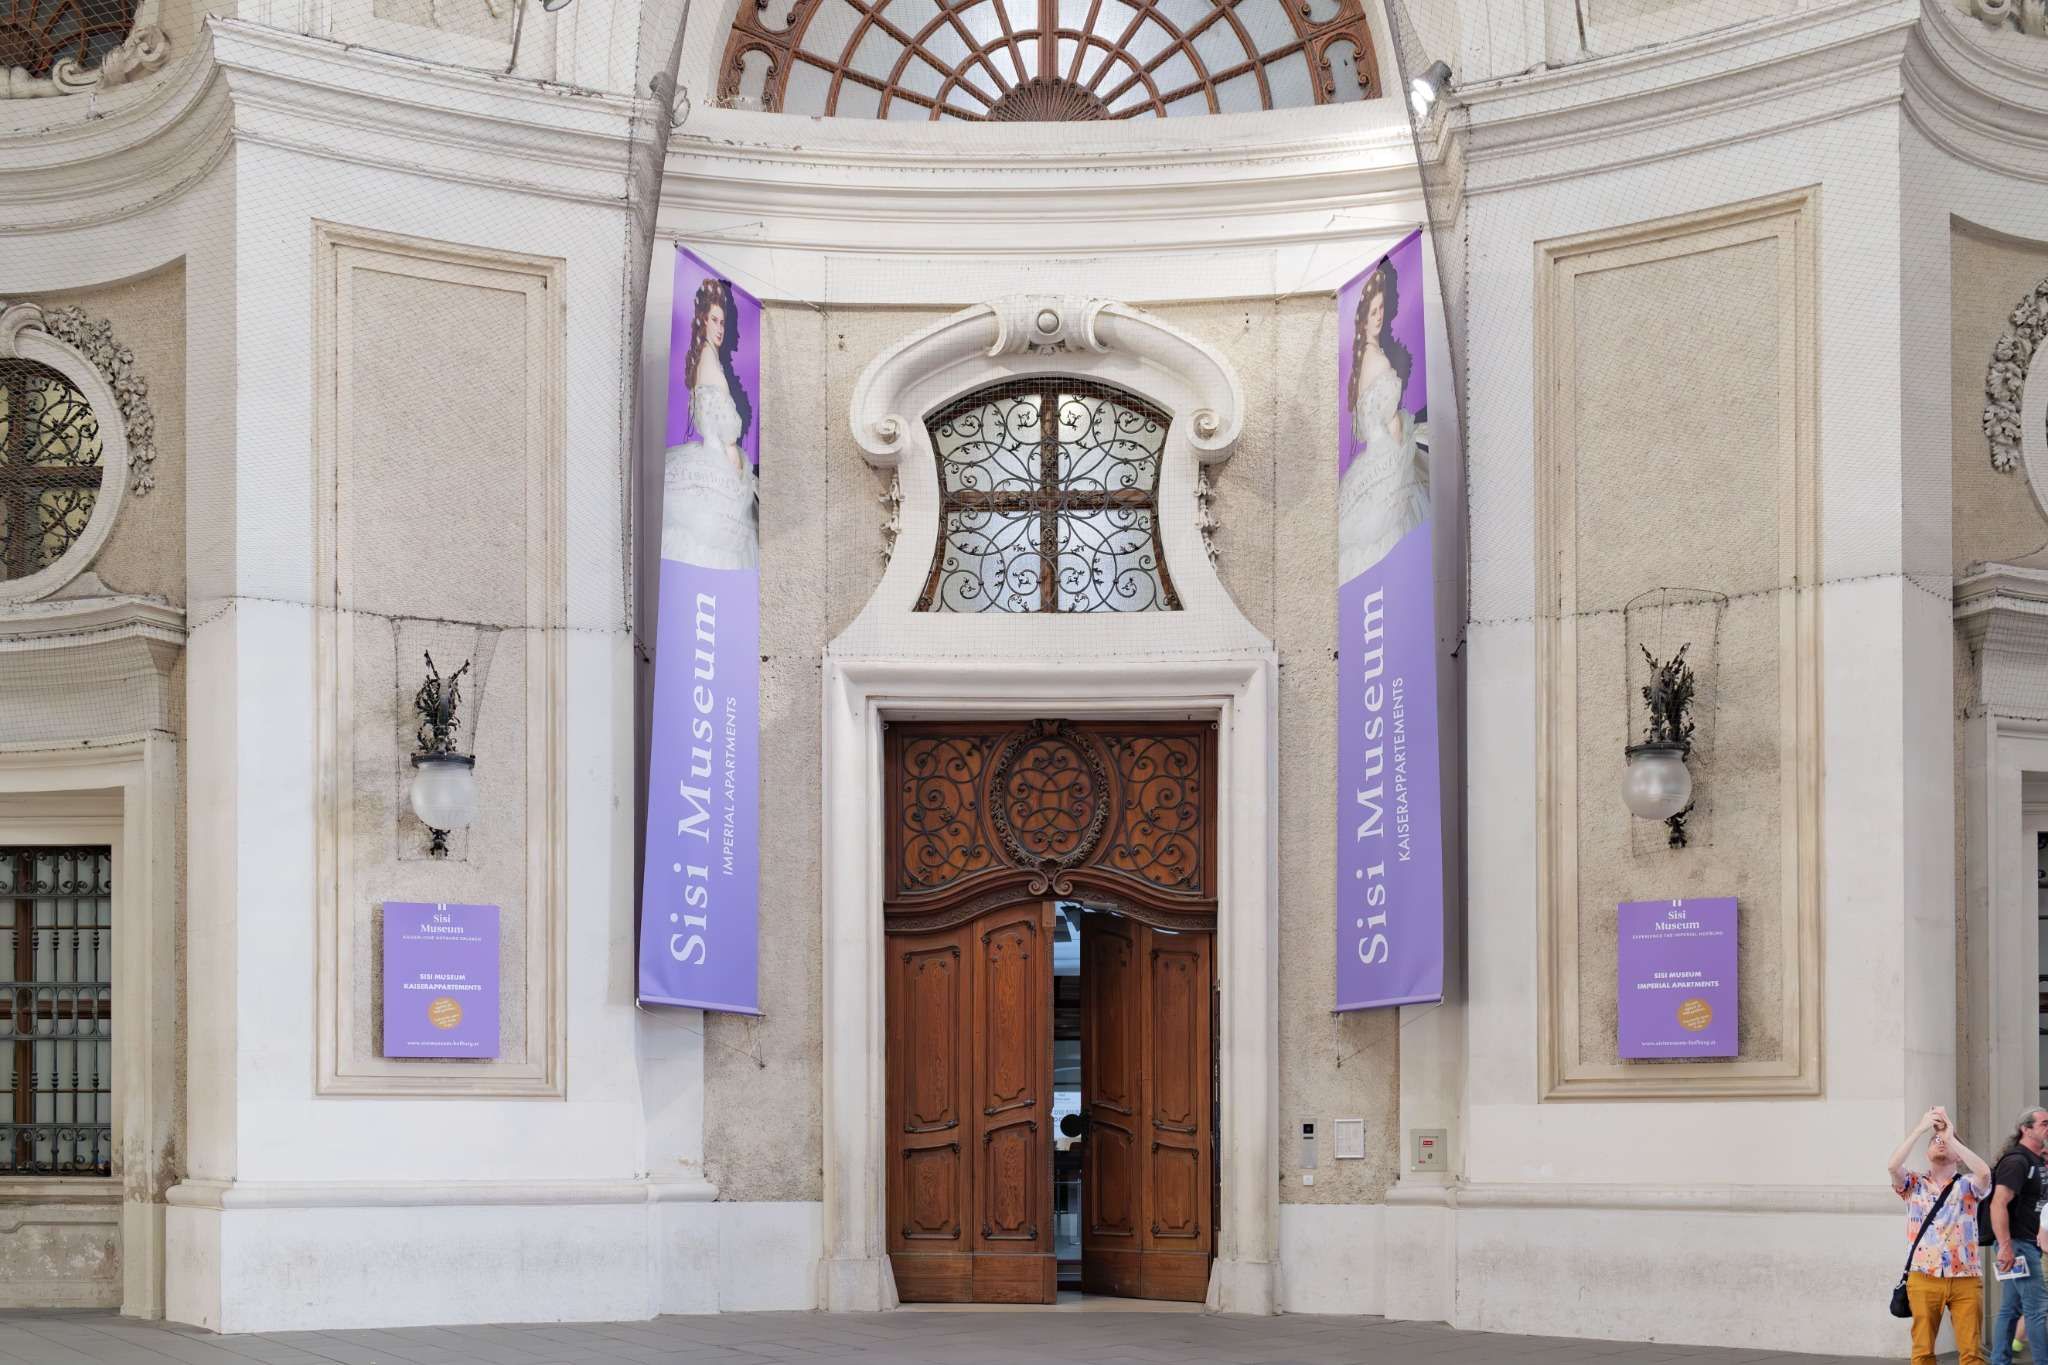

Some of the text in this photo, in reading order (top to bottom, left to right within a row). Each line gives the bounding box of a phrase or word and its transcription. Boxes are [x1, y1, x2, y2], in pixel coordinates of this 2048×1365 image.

[1356, 584, 1389, 964] Sisi Museum
[1392, 677, 1411, 862] KAISERAPPARTEMENTS
[671, 591, 720, 965] Sisi Museum
[723, 696, 737, 875] IMPERIAL APARTMENTS
[433, 913, 451, 924] Sisi
[1667, 910, 1687, 920] Sisi
[420, 924, 464, 934] Museum
[1655, 921, 1700, 931] Museum
[419, 973, 433, 981] SISI
[1653, 971, 1702, 980] SISI MUSEUM
[1637, 980, 1720, 990] IMPERIAL APARTMENTS
